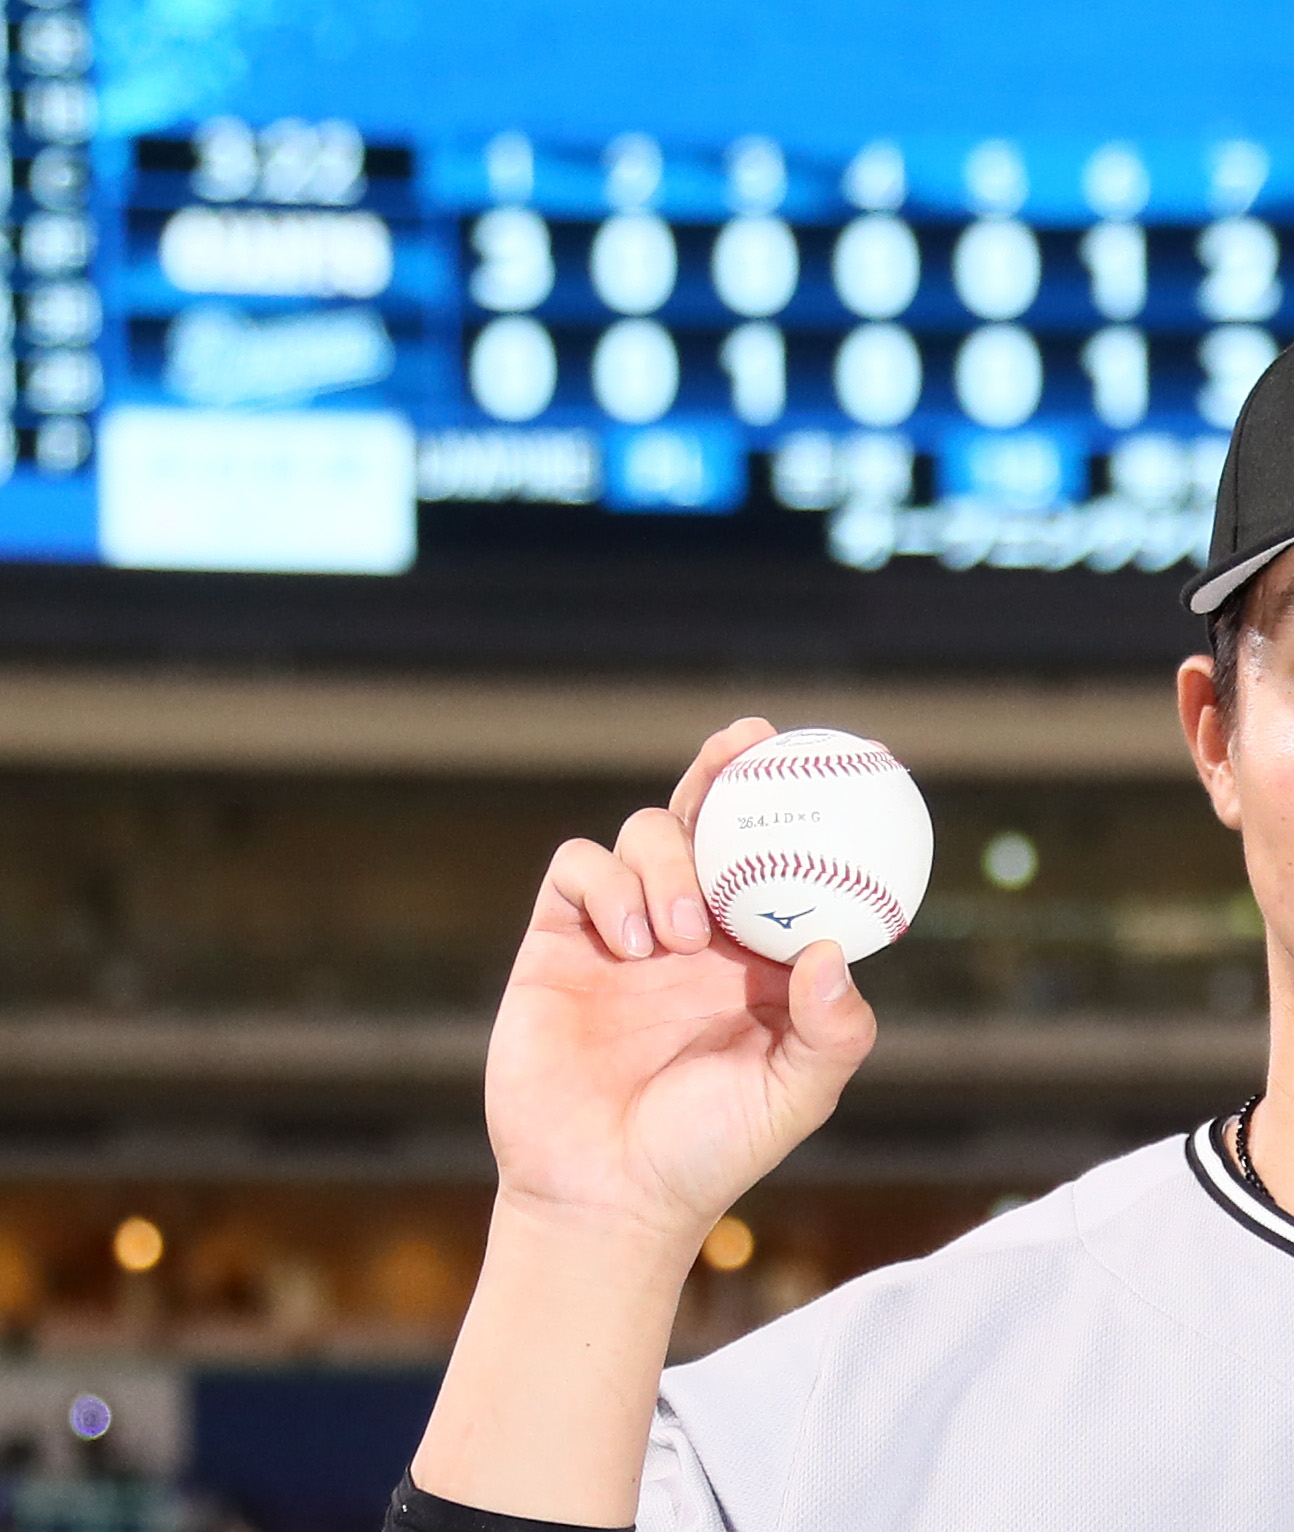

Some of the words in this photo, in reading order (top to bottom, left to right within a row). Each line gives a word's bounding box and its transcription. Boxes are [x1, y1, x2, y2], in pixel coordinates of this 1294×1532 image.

[478, 209, 551, 310] 3
[593, 214, 674, 311] 0
[714, 215, 796, 313] 0
[835, 216, 917, 315] 0
[956, 217, 1038, 317] 0
[1086, 220, 1145, 317] 1
[473, 318, 554, 419] 0
[595, 319, 676, 421] 0
[725, 323, 784, 421] 1
[837, 325, 919, 426] 0
[957, 326, 1039, 426] 0
[1088, 328, 1147, 427] 1
